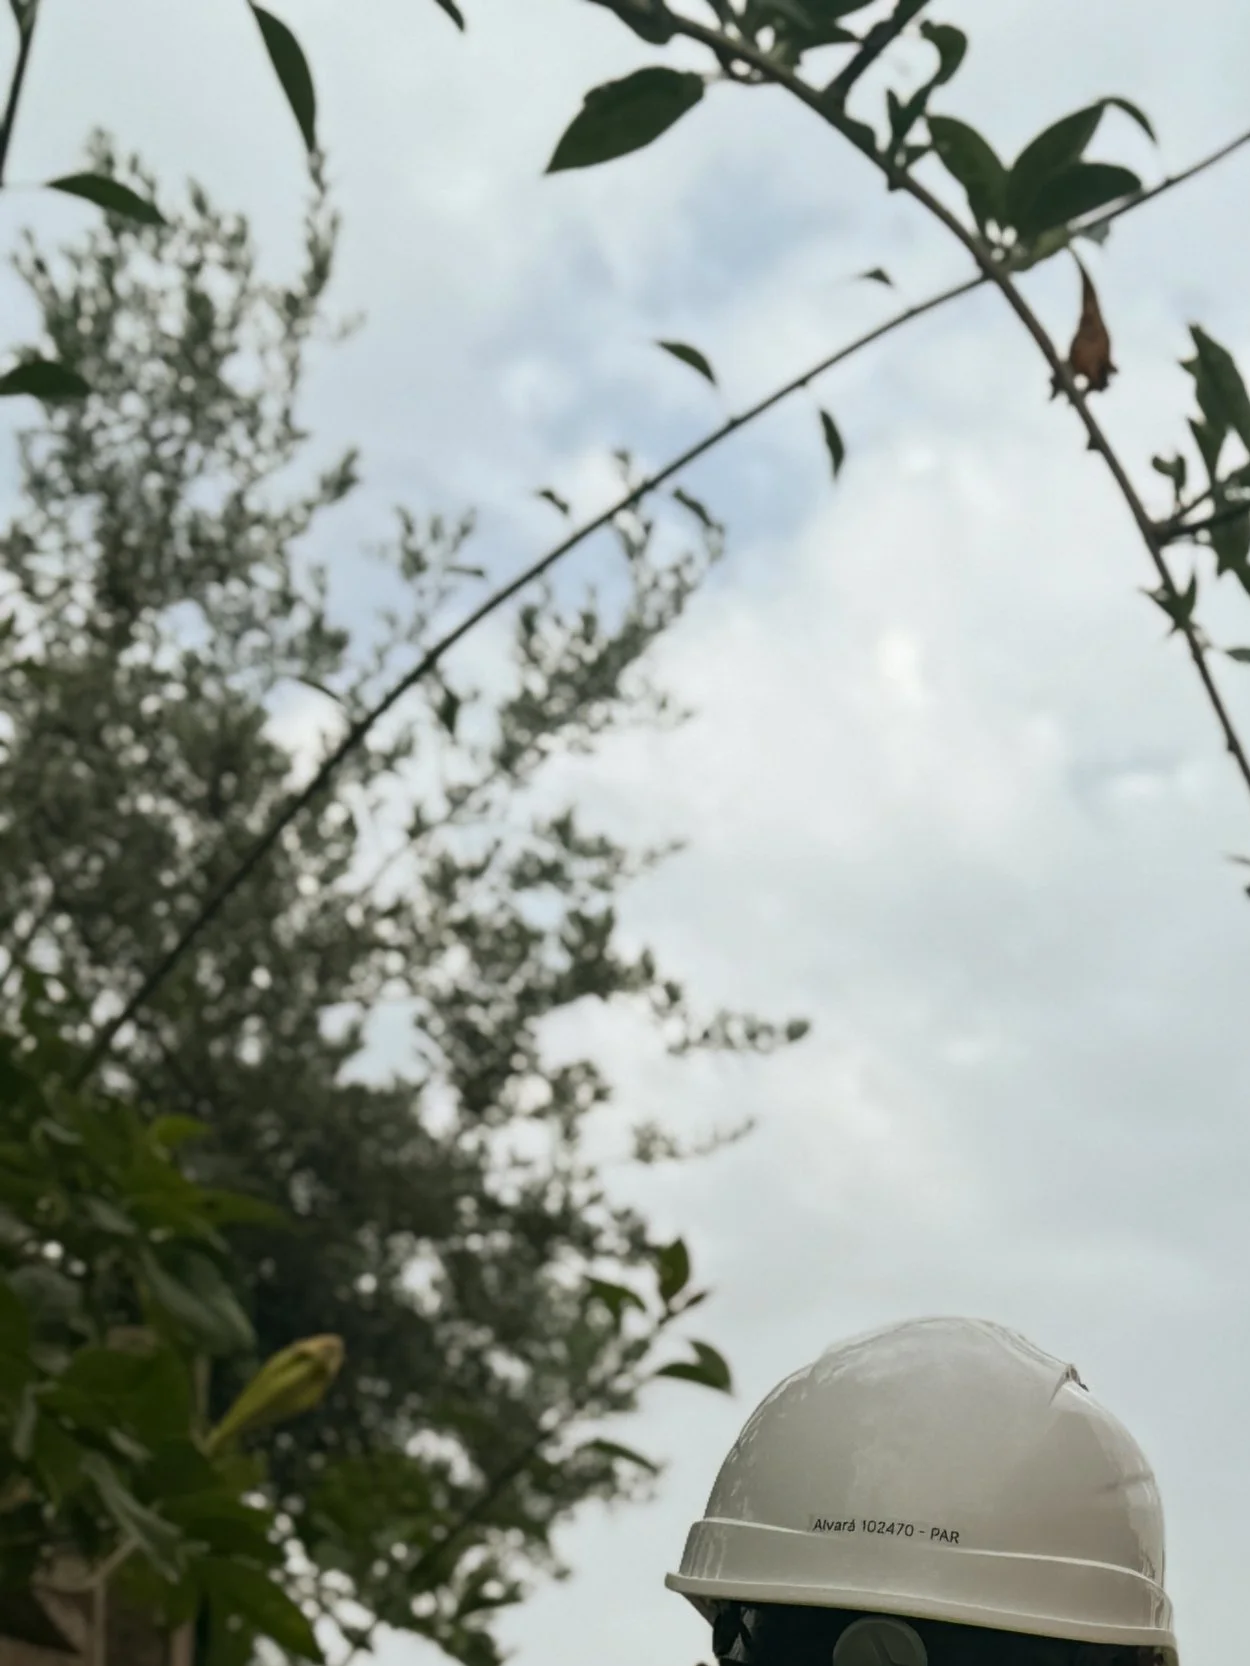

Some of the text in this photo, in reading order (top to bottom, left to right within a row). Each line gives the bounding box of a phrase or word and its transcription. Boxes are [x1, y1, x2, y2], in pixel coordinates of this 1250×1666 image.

[813, 1518, 856, 1532] Alvará
[862, 1519, 915, 1537] 102470
[930, 1527, 960, 1544] PAR
